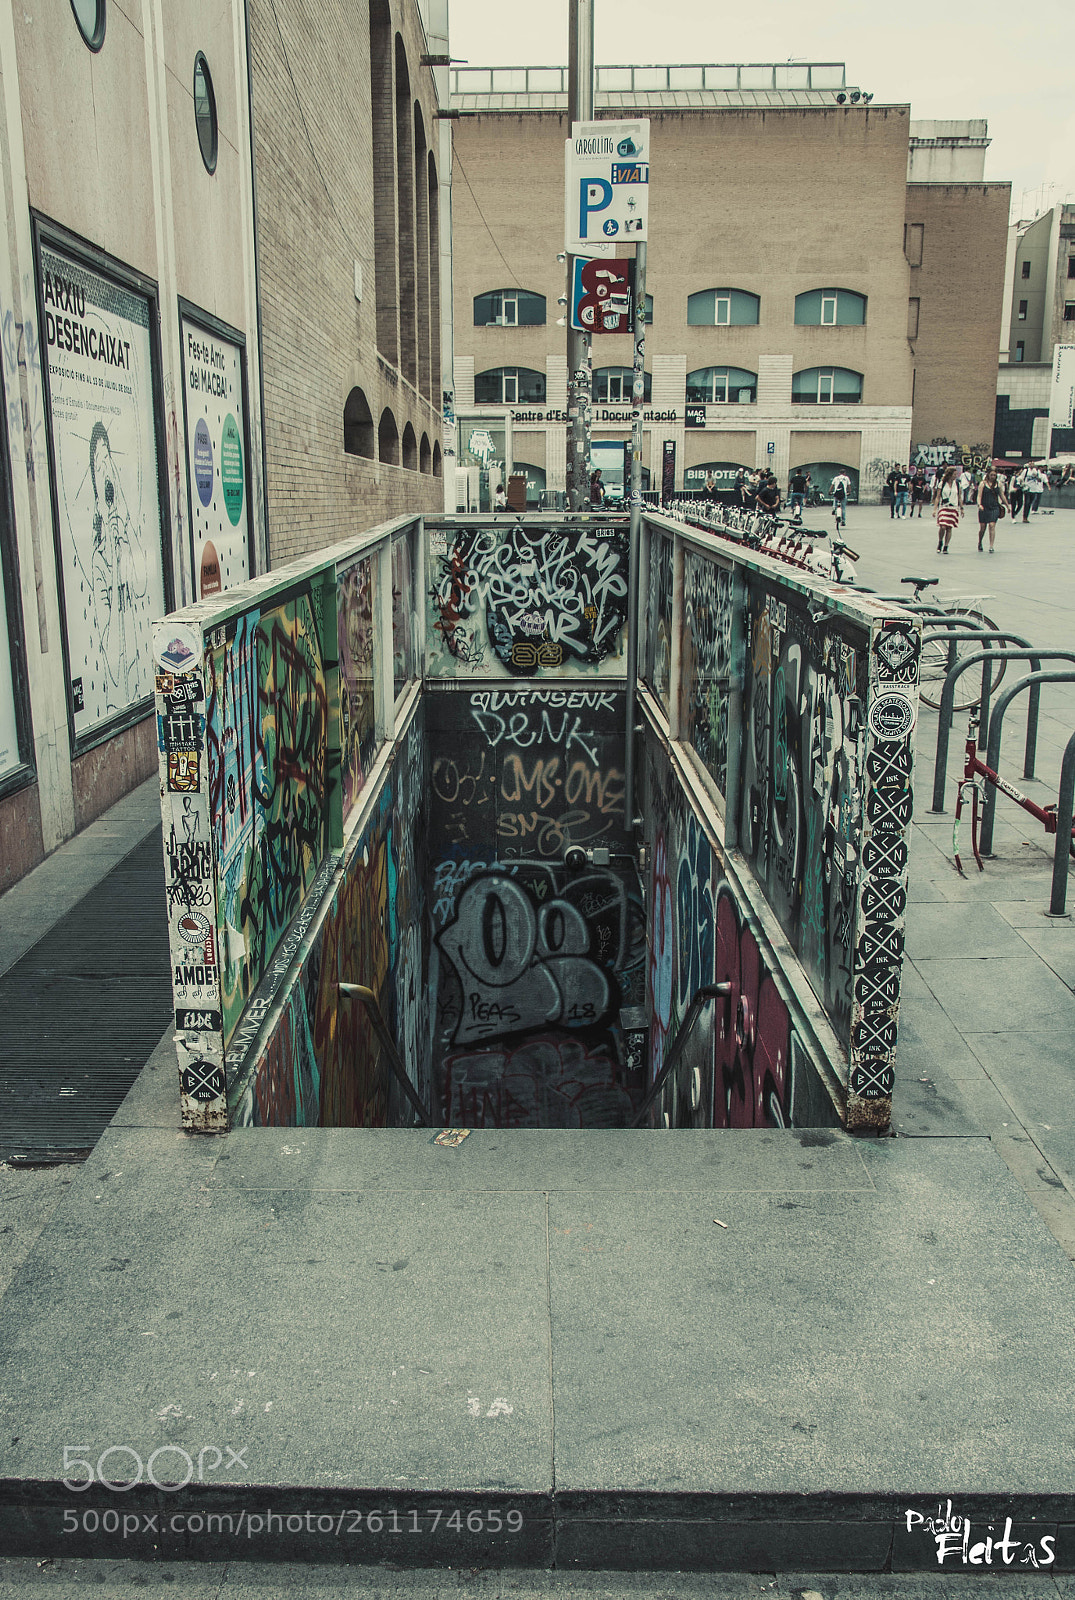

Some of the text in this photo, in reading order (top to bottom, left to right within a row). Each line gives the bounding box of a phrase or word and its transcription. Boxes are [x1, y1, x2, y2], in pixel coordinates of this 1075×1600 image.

[44, 271, 85, 319] ARXIU
[46, 310, 130, 371] DESENCAIXAT
[188, 333, 225, 371] Fes-te Amic
[189, 365, 200, 391] del
[886, 775, 899, 783] INK
[881, 821, 895, 829] INK
[876, 956, 889, 964] INK
[469, 992, 521, 1023] PEAS
[568, 1003, 597, 1021] 18
